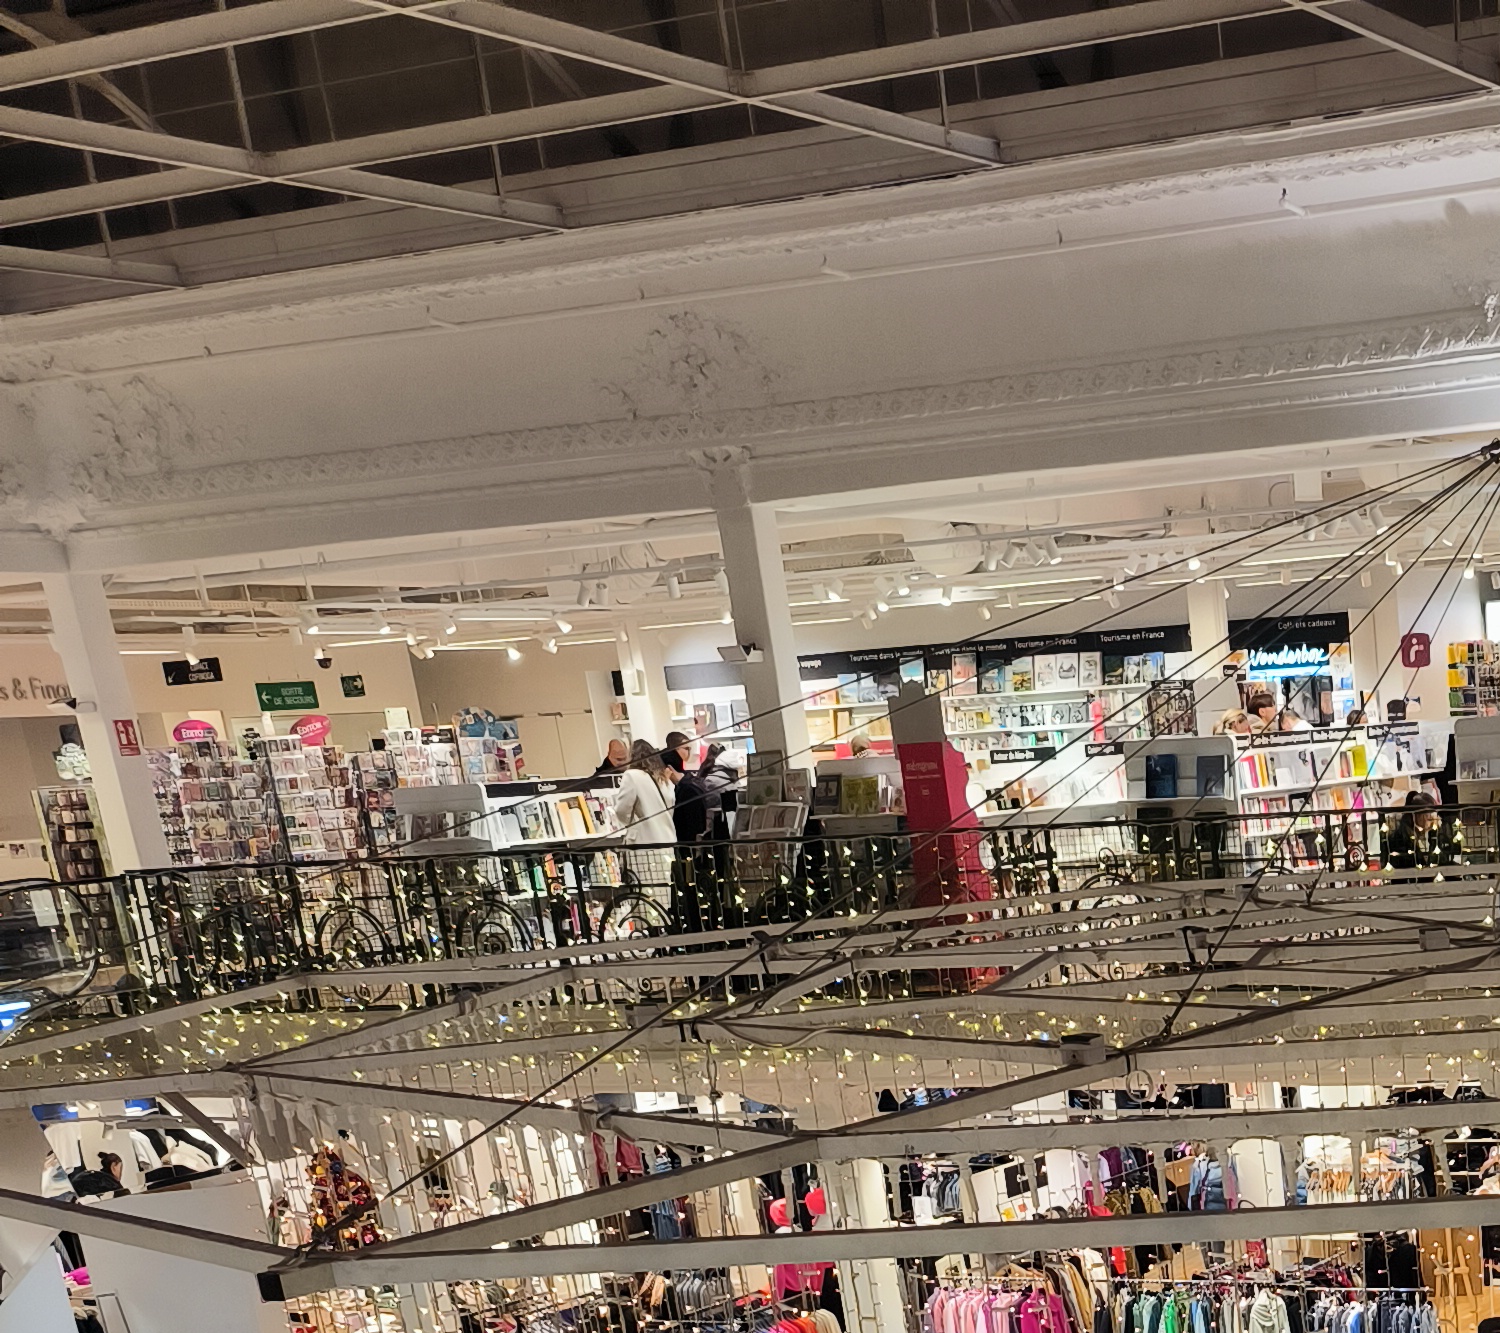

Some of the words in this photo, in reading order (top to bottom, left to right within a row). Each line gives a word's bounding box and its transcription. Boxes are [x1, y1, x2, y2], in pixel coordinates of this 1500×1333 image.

[1307, 619, 1336, 628] cadeaux
[1100, 633, 1131, 643] Tourisme
[1132, 632, 1140, 640] en
[1141, 631, 1165, 640] France
[1014, 639, 1045, 649] Tourisme
[850, 653, 879, 663] Tourisme
[274, 696, 284, 706] DE
